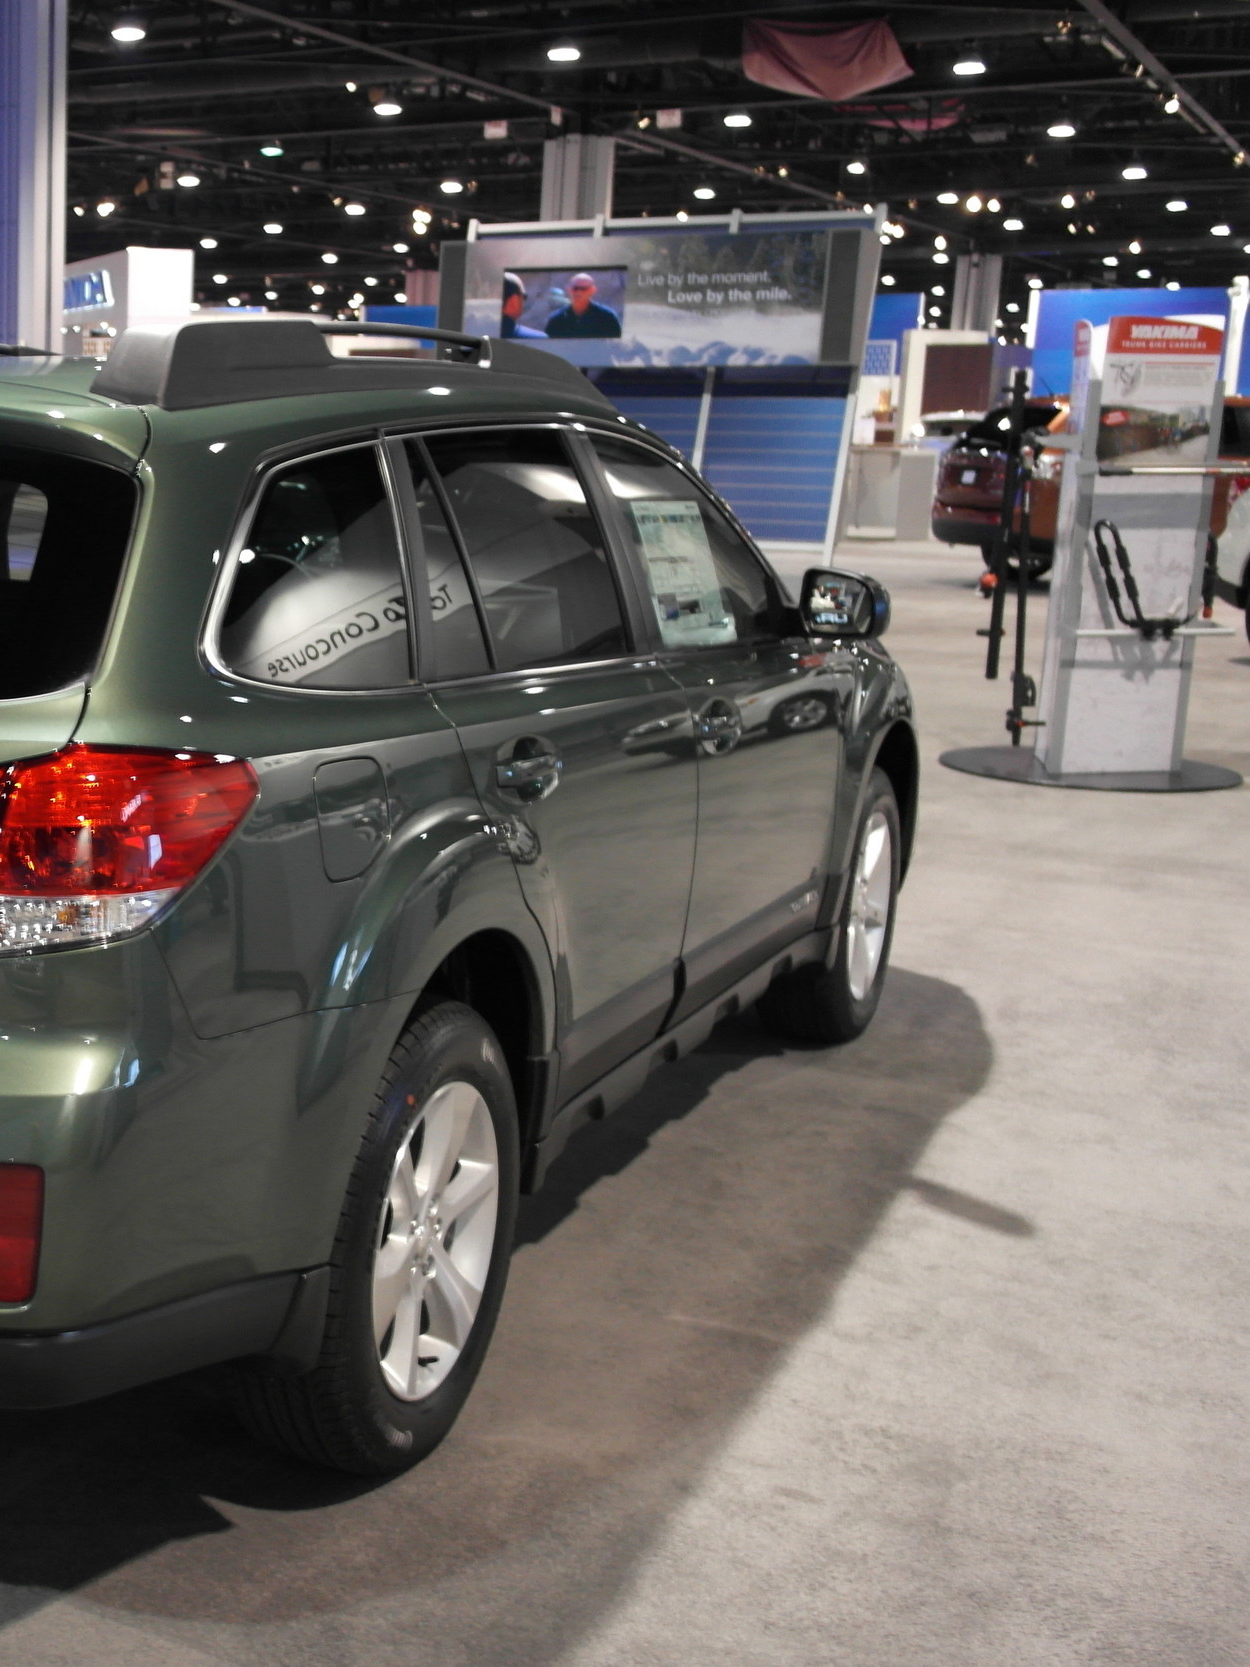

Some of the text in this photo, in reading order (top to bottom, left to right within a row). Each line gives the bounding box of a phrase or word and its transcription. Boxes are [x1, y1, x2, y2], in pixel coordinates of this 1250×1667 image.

[637, 270, 772, 286] Live by the moment.
[667, 286, 793, 304] Love by the mile.
[1130, 324, 1199, 339] YAKIMA
